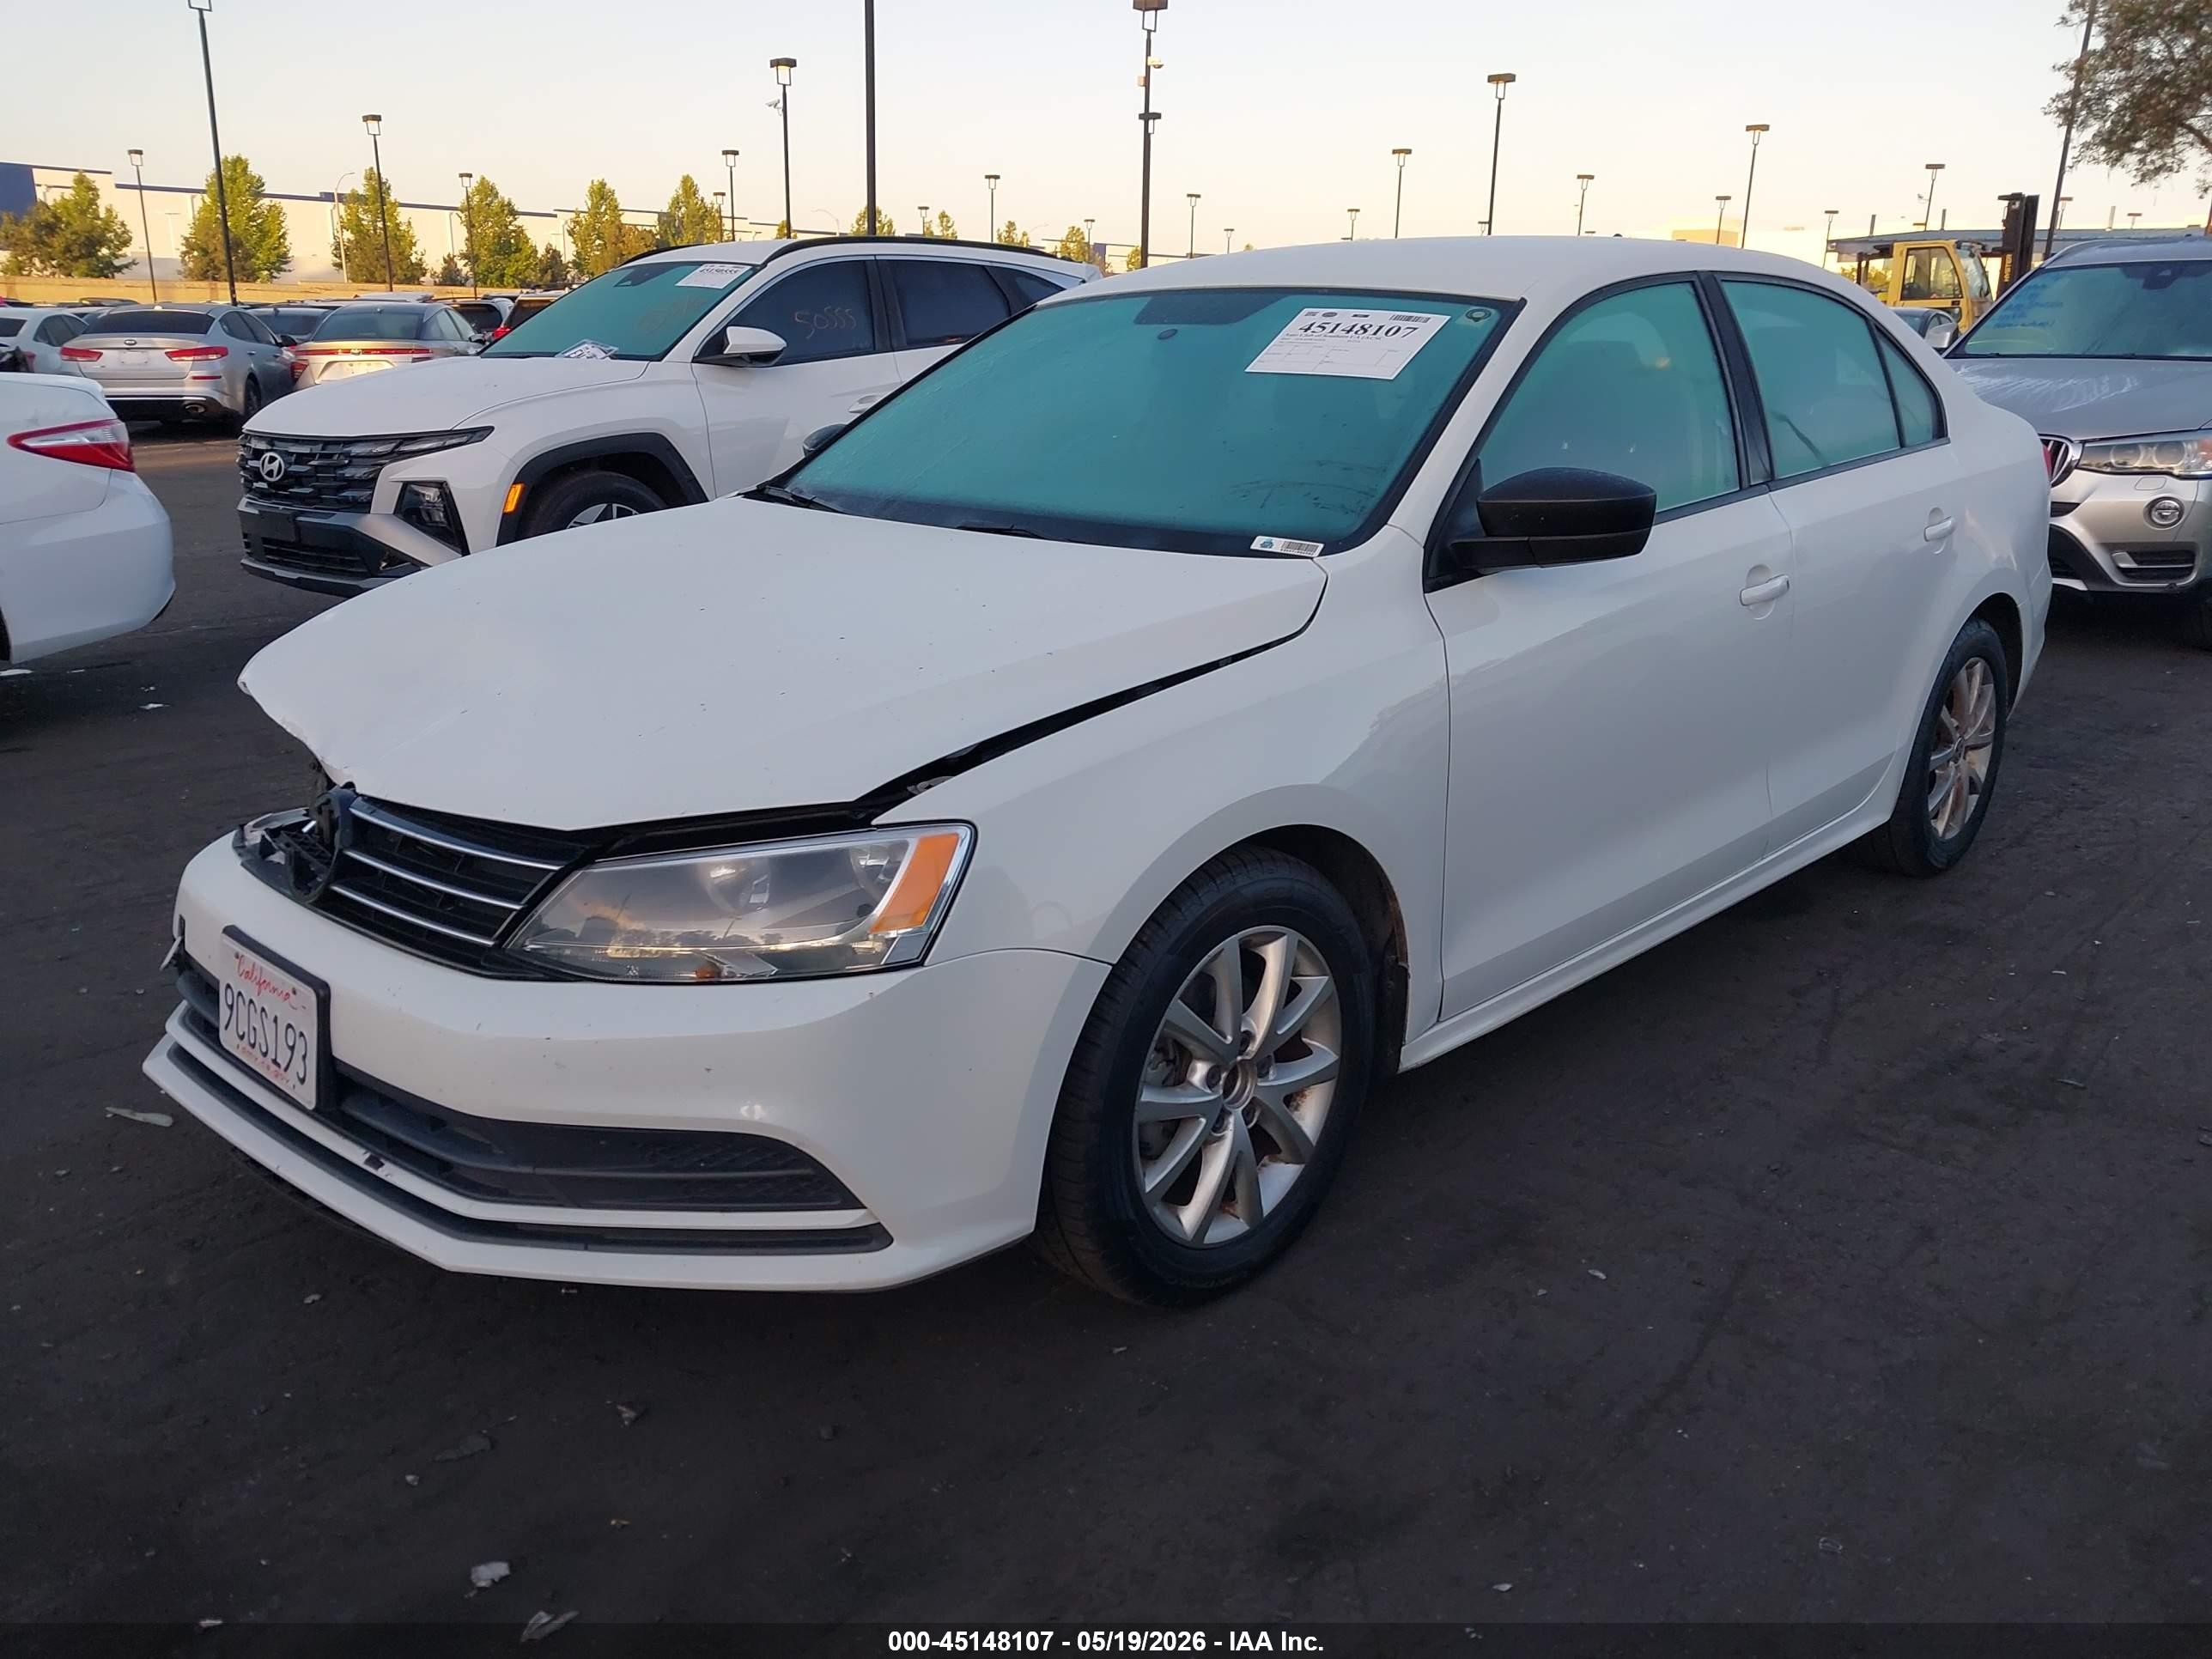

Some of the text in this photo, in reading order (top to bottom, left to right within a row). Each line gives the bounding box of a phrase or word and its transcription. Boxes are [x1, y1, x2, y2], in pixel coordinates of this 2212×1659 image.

[1298, 321, 1419, 338] 45148107
[236, 953, 298, 1011] California
[224, 982, 307, 1085] 9CGS193
